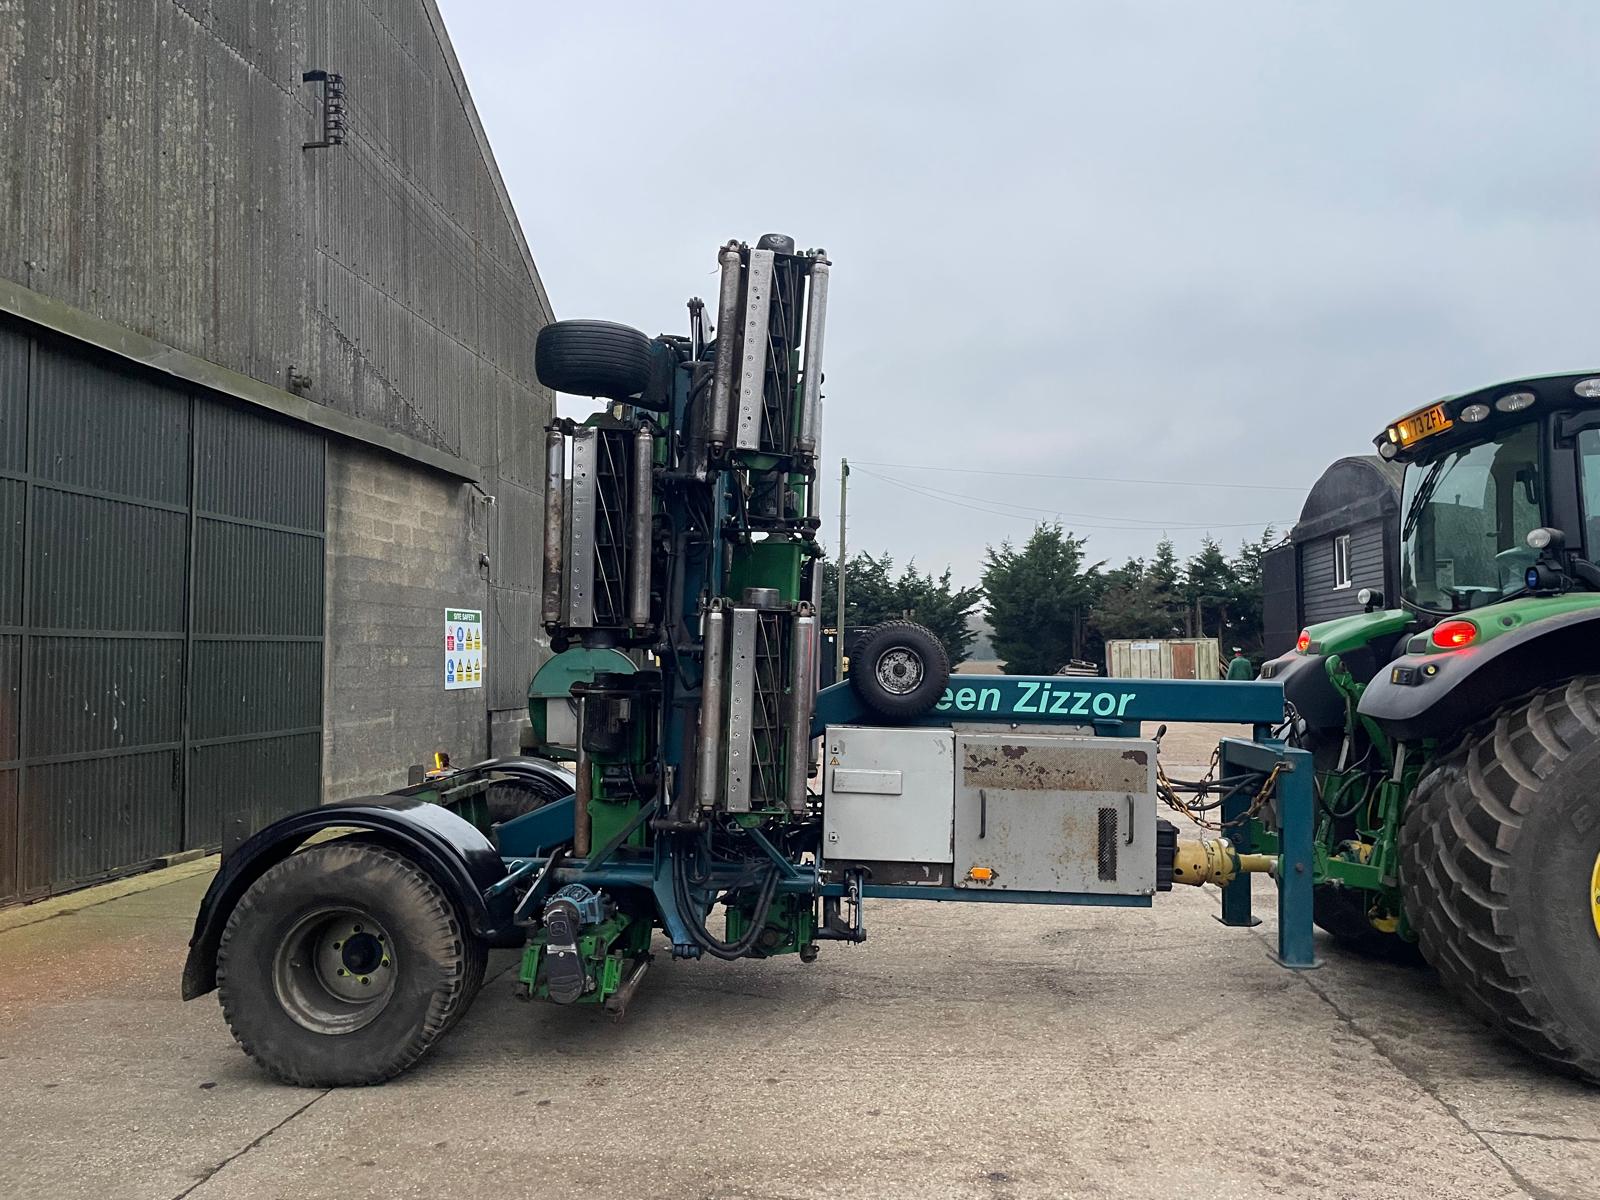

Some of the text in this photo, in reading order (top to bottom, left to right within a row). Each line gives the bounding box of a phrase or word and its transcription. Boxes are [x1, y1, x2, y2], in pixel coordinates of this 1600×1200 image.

[1399, 416, 1425, 440] Y73
[453, 612, 475, 622] SITE SAFETY
[1012, 681, 1136, 716] Zizzor
